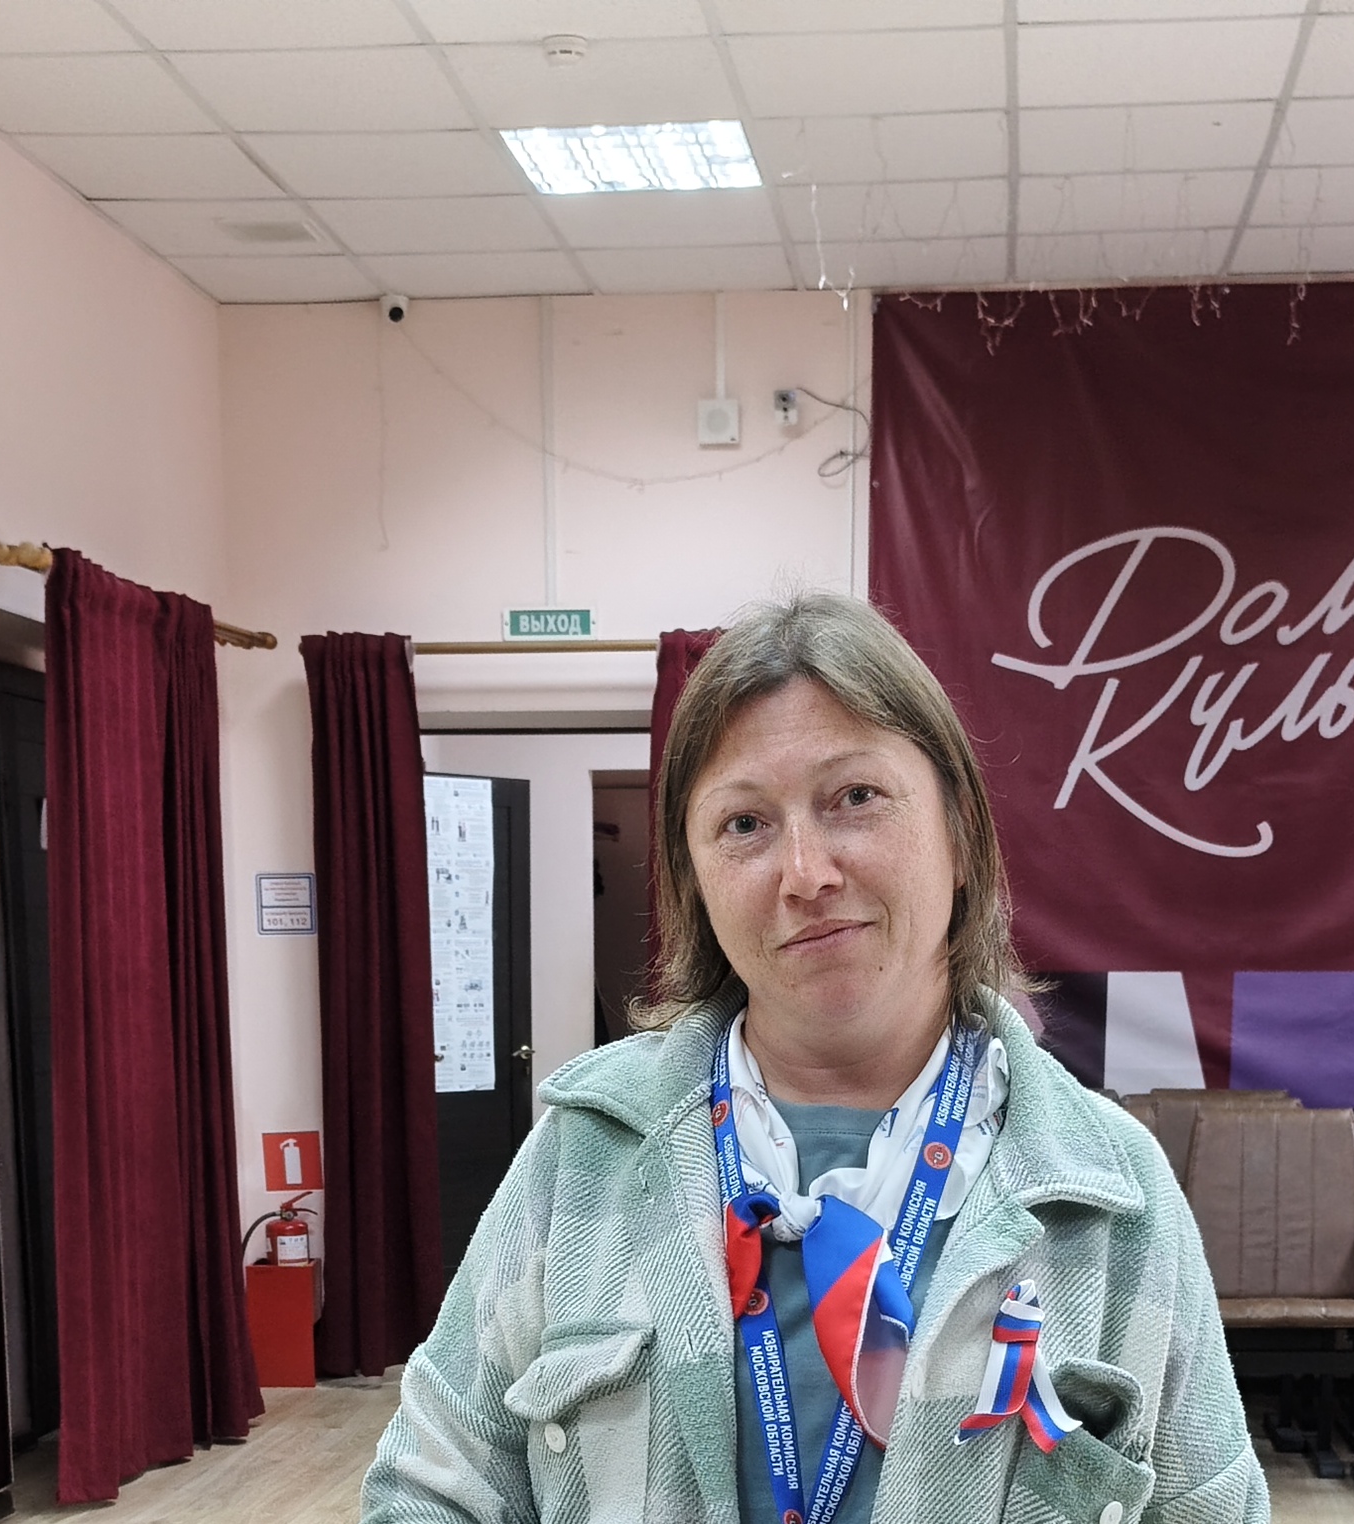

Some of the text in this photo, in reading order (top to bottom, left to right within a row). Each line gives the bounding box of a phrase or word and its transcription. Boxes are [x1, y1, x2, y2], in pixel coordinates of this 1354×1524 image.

[519, 614, 583, 635] ВЫХОД
[934, 1054, 961, 1127] ИЗБИРАТЕЛЬНАЯ
[724, 1133, 742, 1201] ИЗБИРАТЕЛЬ
[898, 1179, 927, 1238] КОМИССИЯ
[900, 1245, 922, 1291] ОВСКОЙ
[912, 1197, 937, 1245] ОБЛАСТИ
[749, 1345, 784, 1476] МОСКОВСКОЙ ОБЛАСТИ
[762, 1329, 799, 1490] ИЗБИРАТЕЛЬНАЯ КОМИССИЯ
[845, 1418, 864, 1455] ОБЛА
